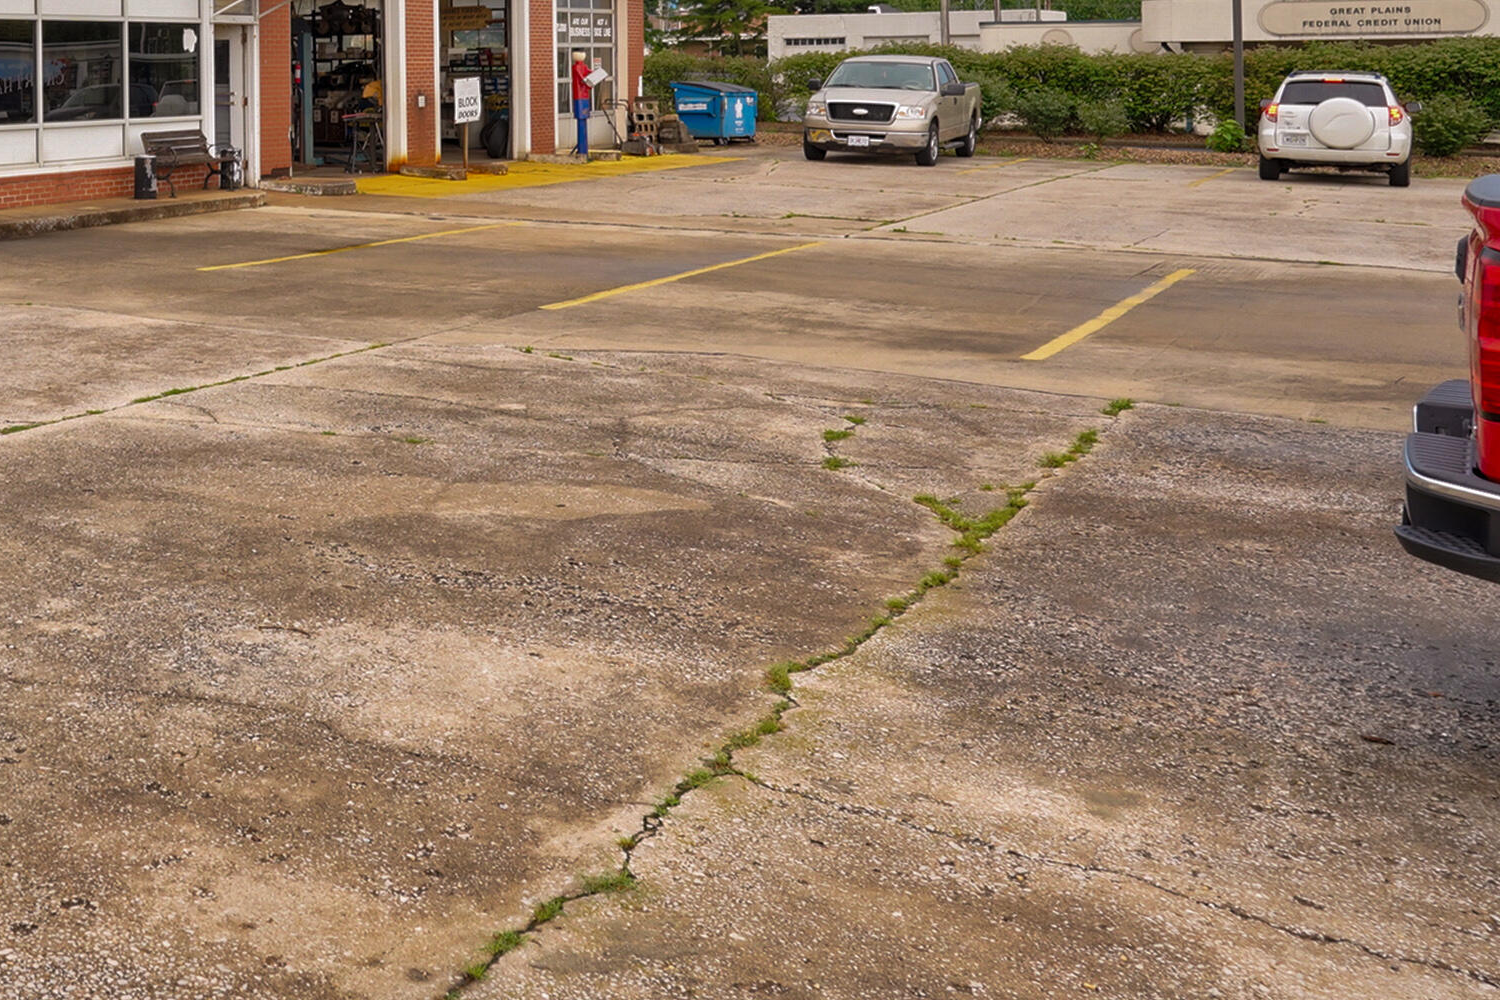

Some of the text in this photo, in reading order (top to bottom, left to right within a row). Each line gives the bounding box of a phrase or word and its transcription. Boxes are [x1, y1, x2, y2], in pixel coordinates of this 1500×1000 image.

[1329, 6, 1411, 15] GREAT PLAINS
[1357, 19, 1398, 27] CREDIT
[1404, 18, 1441, 26] UNION
[458, 96, 477, 108] BLOCK
[458, 110, 477, 119] DOORS
